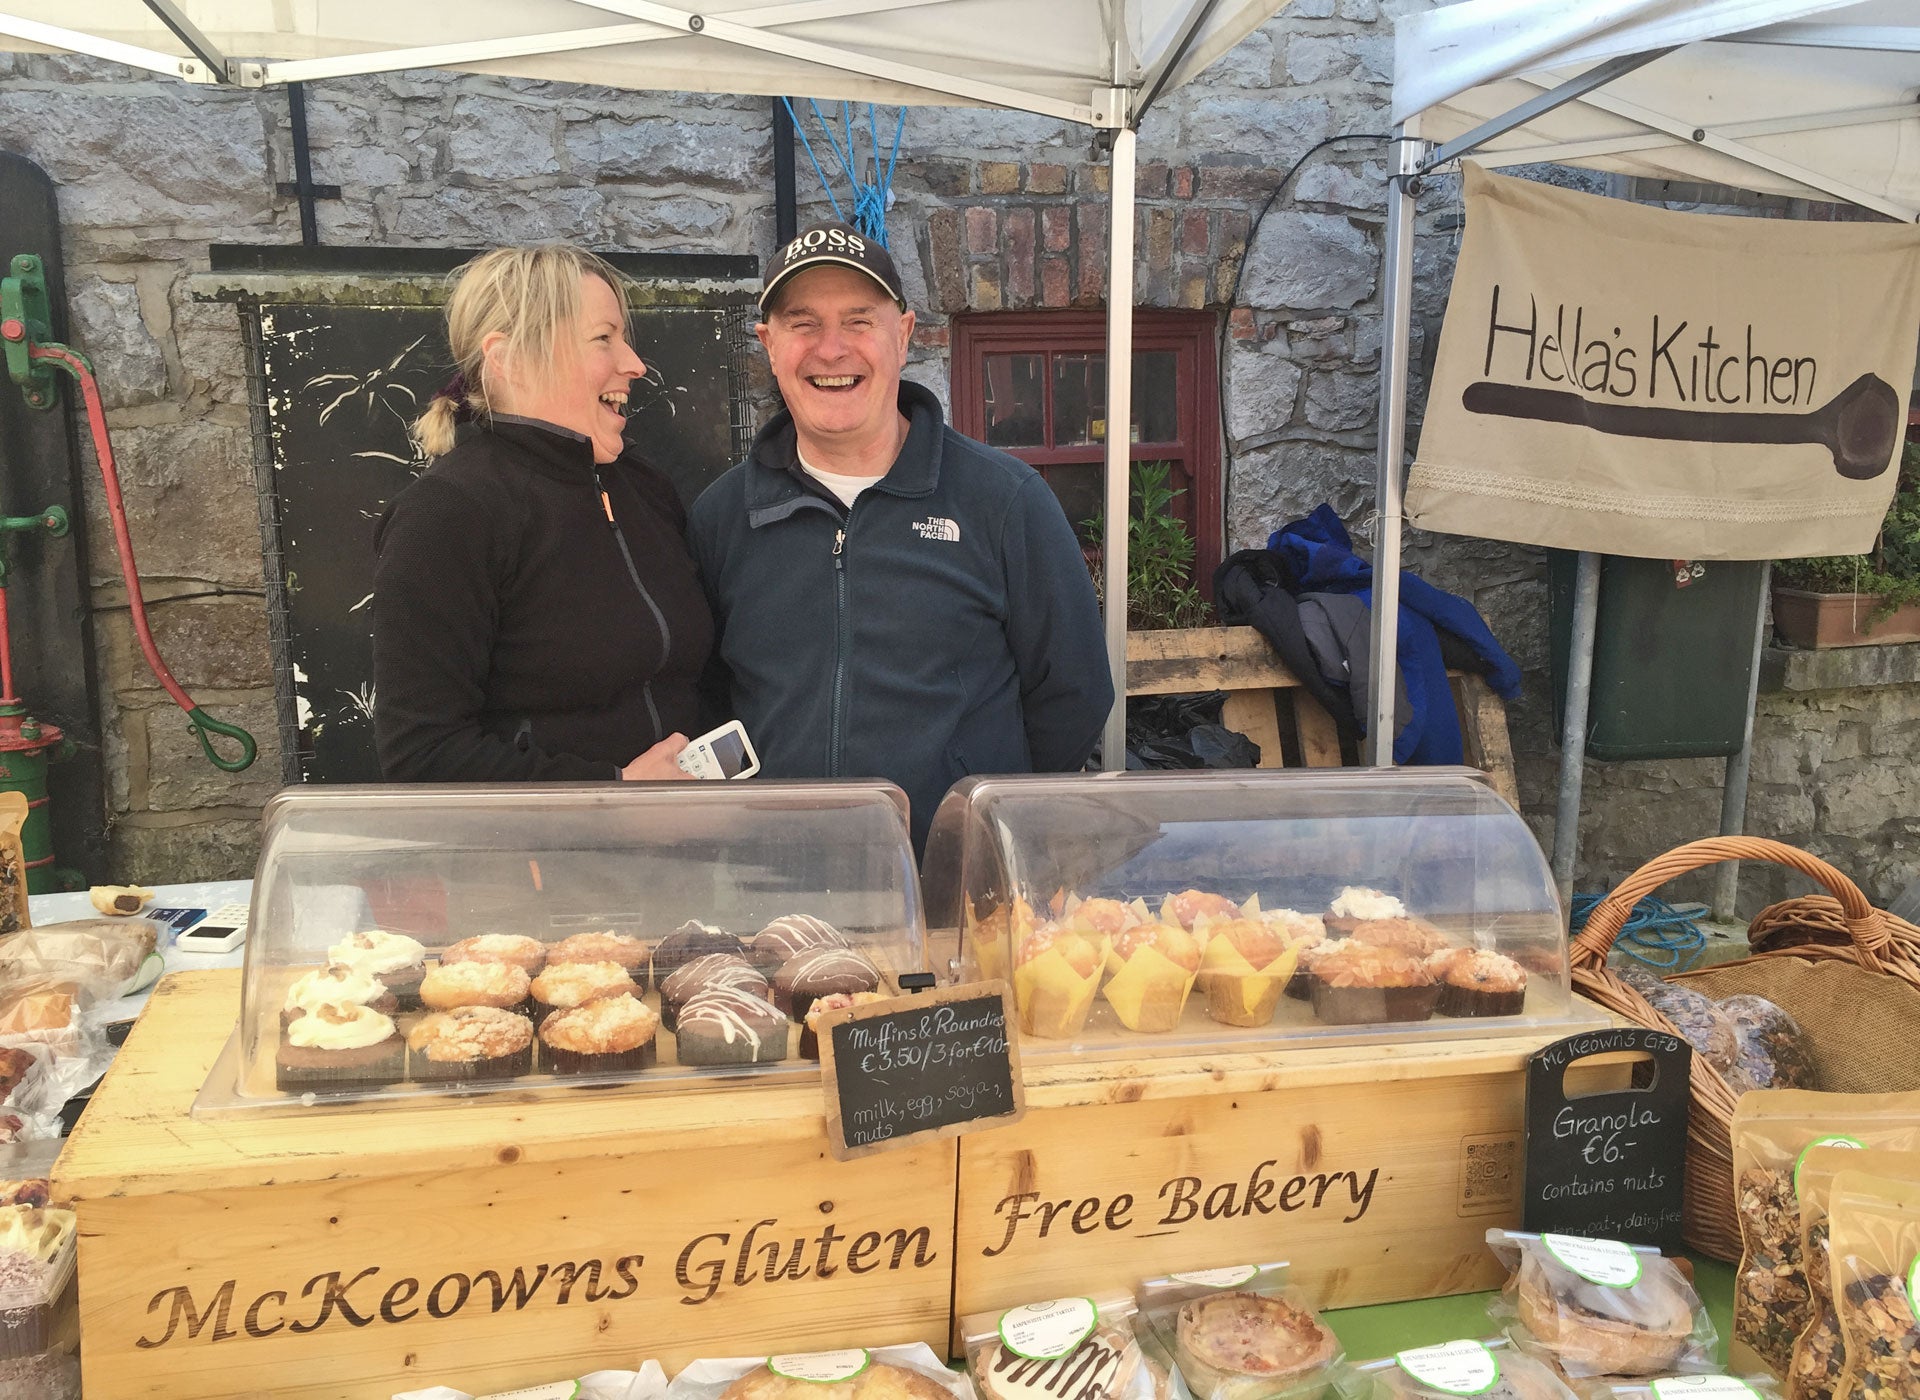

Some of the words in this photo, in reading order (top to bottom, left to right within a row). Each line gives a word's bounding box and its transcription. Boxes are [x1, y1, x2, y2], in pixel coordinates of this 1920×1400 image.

[784, 246, 818, 266] HUGO
[785, 229, 866, 260] BOSS
[1484, 284, 1637, 397] Hella's
[1649, 314, 1817, 405] Kitchen
[912, 521, 945, 533] NORTH
[920, 530, 944, 541] FACE
[927, 516, 945, 526] THE
[848, 1021, 917, 1051] Muffins
[919, 1015, 932, 1038] &
[1568, 1031, 1636, 1058] Keowns
[1643, 1031, 1679, 1052] GFB
[853, 1098, 905, 1125] milk,
[906, 1095, 943, 1120] egg,
[1552, 1101, 1661, 1138] Granola
[853, 1121, 893, 1145] nuts
[1542, 1174, 1615, 1201] contains
[1623, 1167, 1666, 1191] nuts
[981, 1190, 1134, 1257] Free
[1157, 1159, 1380, 1225] Bakery
[135, 1254, 645, 1350] McKeowns
[675, 1218, 937, 1306] Gluten
